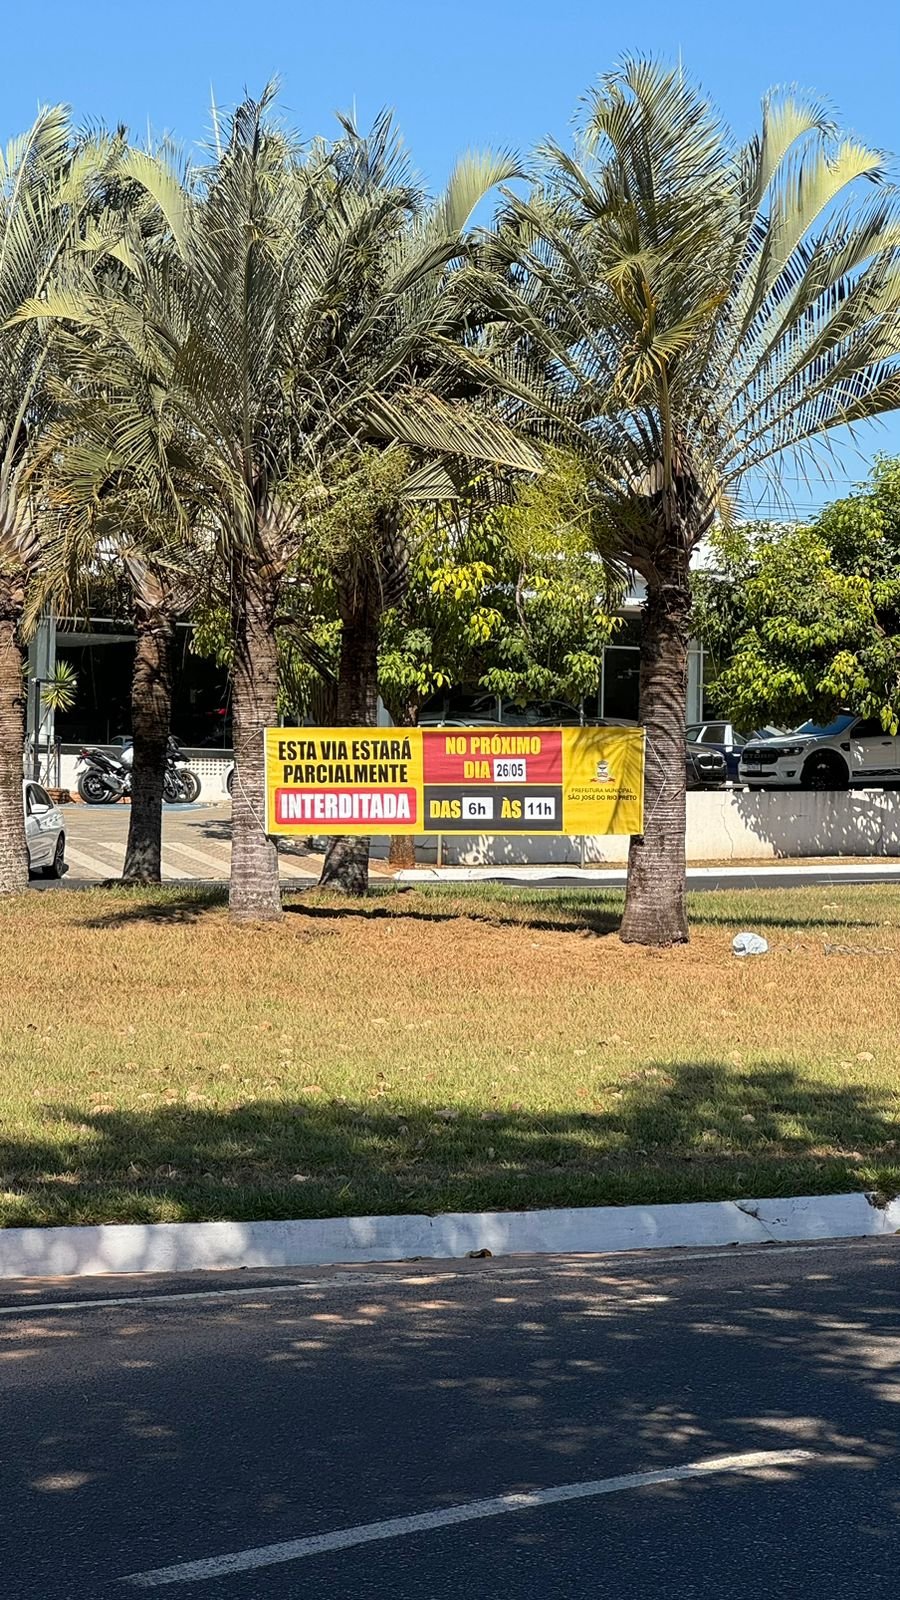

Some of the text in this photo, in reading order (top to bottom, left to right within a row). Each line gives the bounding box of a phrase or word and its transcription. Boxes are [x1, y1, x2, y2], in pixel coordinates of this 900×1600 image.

[278, 736, 411, 760] ESTA VIA ESTARÁ
[445, 734, 541, 755] NO PRÓXIMO
[283, 764, 408, 783] PARCIALMENTE
[463, 760, 524, 779] DIA 26/05
[281, 793, 411, 819] INTERDITADA
[429, 797, 552, 818] DAS 6h ÀS 11h
[568, 793, 580, 801] SÃO
